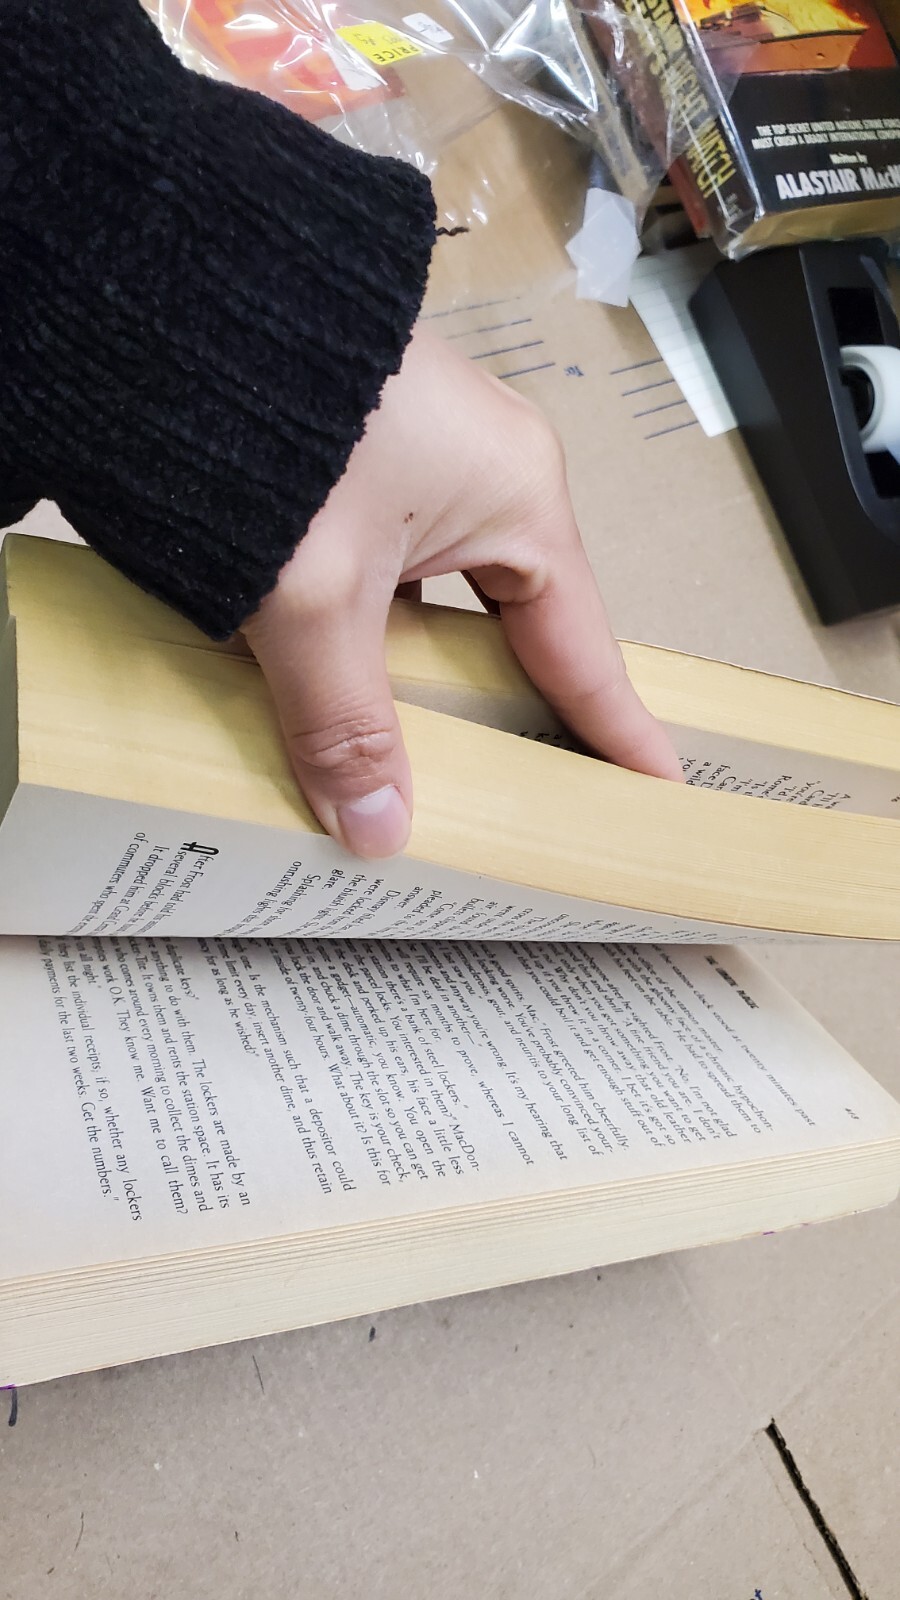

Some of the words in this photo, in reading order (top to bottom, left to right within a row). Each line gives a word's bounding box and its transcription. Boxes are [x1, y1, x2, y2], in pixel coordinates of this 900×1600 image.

[373, 45, 419, 62] PRICE
[683, 117, 737, 198] WATCH
[775, 167, 862, 201] ALASTAIR
[708, 764, 731, 780] face
[134, 832, 149, 843] of
[109, 843, 140, 884] commuters
[133, 853, 163, 886] dropped
[163, 851, 187, 878] several
[148, 878, 175, 900] blocks
[180, 870, 204, 889] Frost
[266, 861, 302, 898] onrushing
[321, 868, 345, 890] glare.
[348, 874, 368, 887] the
[363, 878, 384, 896] were
[100, 885, 118, 899] who
[124, 885, 145, 898] him
[170, 889, 191, 902] had
[281, 873, 321, 907] Splashing
[329, 887, 358, 907] bluish
[160, 901, 177, 917] told
[252, 898, 278, 914] lights
[342, 896, 372, 916] locked
[366, 889, 401, 913] Dismay
[412, 889, 442, 914] pleaded
[66, 974, 82, 988] the
[297, 971, 313, 984] the
[163, 984, 174, 993] to
[305, 985, 323, 1005] door
[53, 996, 69, 1008] for
[70, 990, 95, 1031] individual
[167, 995, 182, 1006] do
[57, 1010, 73, 1024] the
[114, 1008, 133, 1032] They
[172, 1008, 191, 1027] with
[315, 1005, 334, 1021] and
[61, 1027, 77, 1042] last
[323, 1022, 344, 1042] walk
[66, 1045, 79, 1063] two
[81, 1034, 103, 1073] receipts;
[123, 1035, 142, 1061] know
[190, 1058, 209, 1078] The
[357, 966, 384, 989] parcel
[387, 1015, 405, 1031] You
[397, 1032, 432, 1075] interested
[422, 1077, 435, 1087] in
[447, 1123, 483, 1171] MacDon-
[538, 1027, 561, 1048] Frost
[552, 1049, 586, 1081] greeted
[577, 1082, 597, 1100] him
[94, 1076, 110, 1084] if
[347, 1070, 367, 1091] The
[139, 1085, 159, 1114] Want
[198, 1081, 221, 1116] lockers
[356, 1092, 376, 1110] key
[529, 1039, 565, 1077] probably
[558, 1078, 600, 1125] convinced
[589, 1126, 614, 1153] your-
[79, 1101, 97, 1122] Get
[367, 1111, 380, 1120] is
[85, 1124, 103, 1143] the
[102, 1105, 126, 1149] whether
[148, 1117, 162, 1134] me
[211, 1119, 226, 1135] are
[370, 1122, 392, 1147] your
[154, 1138, 167, 1150] to
[218, 1138, 242, 1169] made
[112, 1153, 130, 1174] any
[159, 1154, 180, 1174] call
[229, 1171, 248, 1187] by
[121, 1178, 145, 1221] lockers
[167, 1179, 194, 1214] them?
[237, 1191, 251, 1206] an
